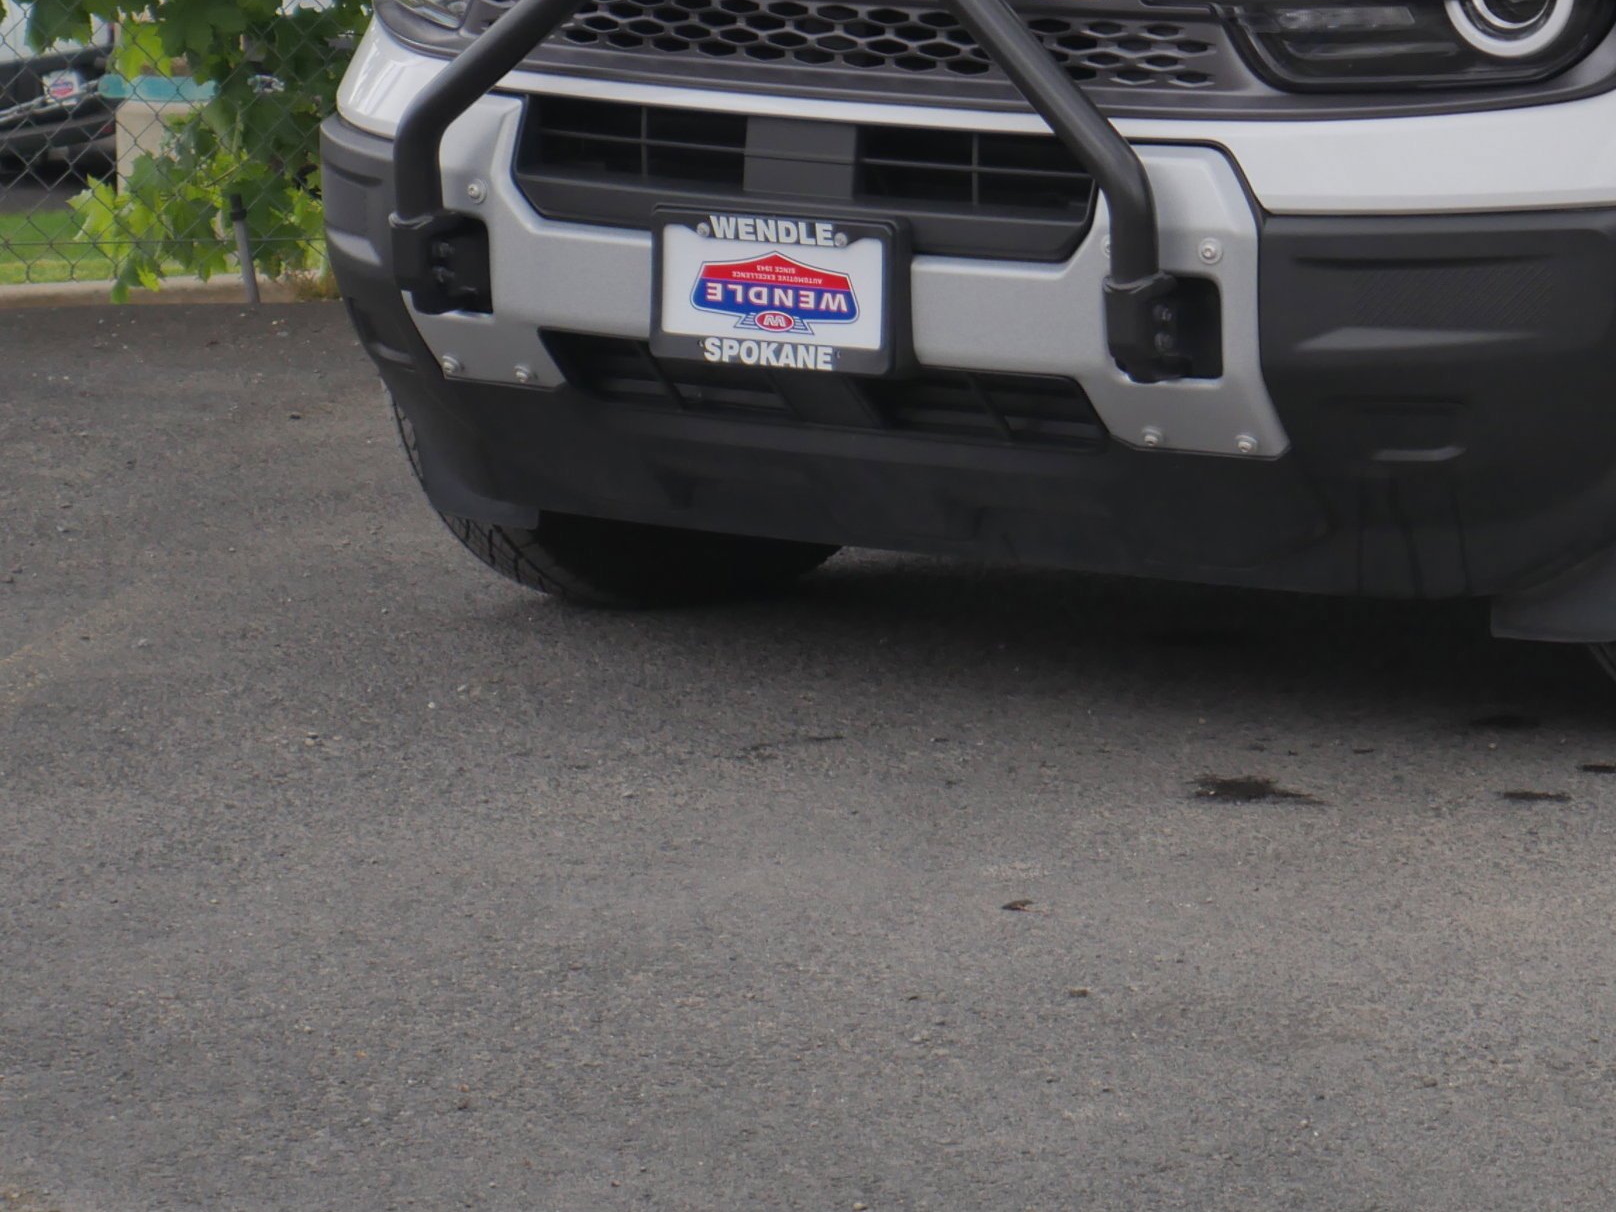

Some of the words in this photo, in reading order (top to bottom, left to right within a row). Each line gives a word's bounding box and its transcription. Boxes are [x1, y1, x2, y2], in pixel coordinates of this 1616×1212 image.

[709, 215, 835, 247] WENDLE
[732, 270, 776, 281] EXCELLENCE
[775, 266, 796, 274] SINCE
[777, 275, 823, 285] AUTOMOTIVE
[706, 282, 848, 313] WENDLE
[703, 337, 834, 372] SPOKANE
